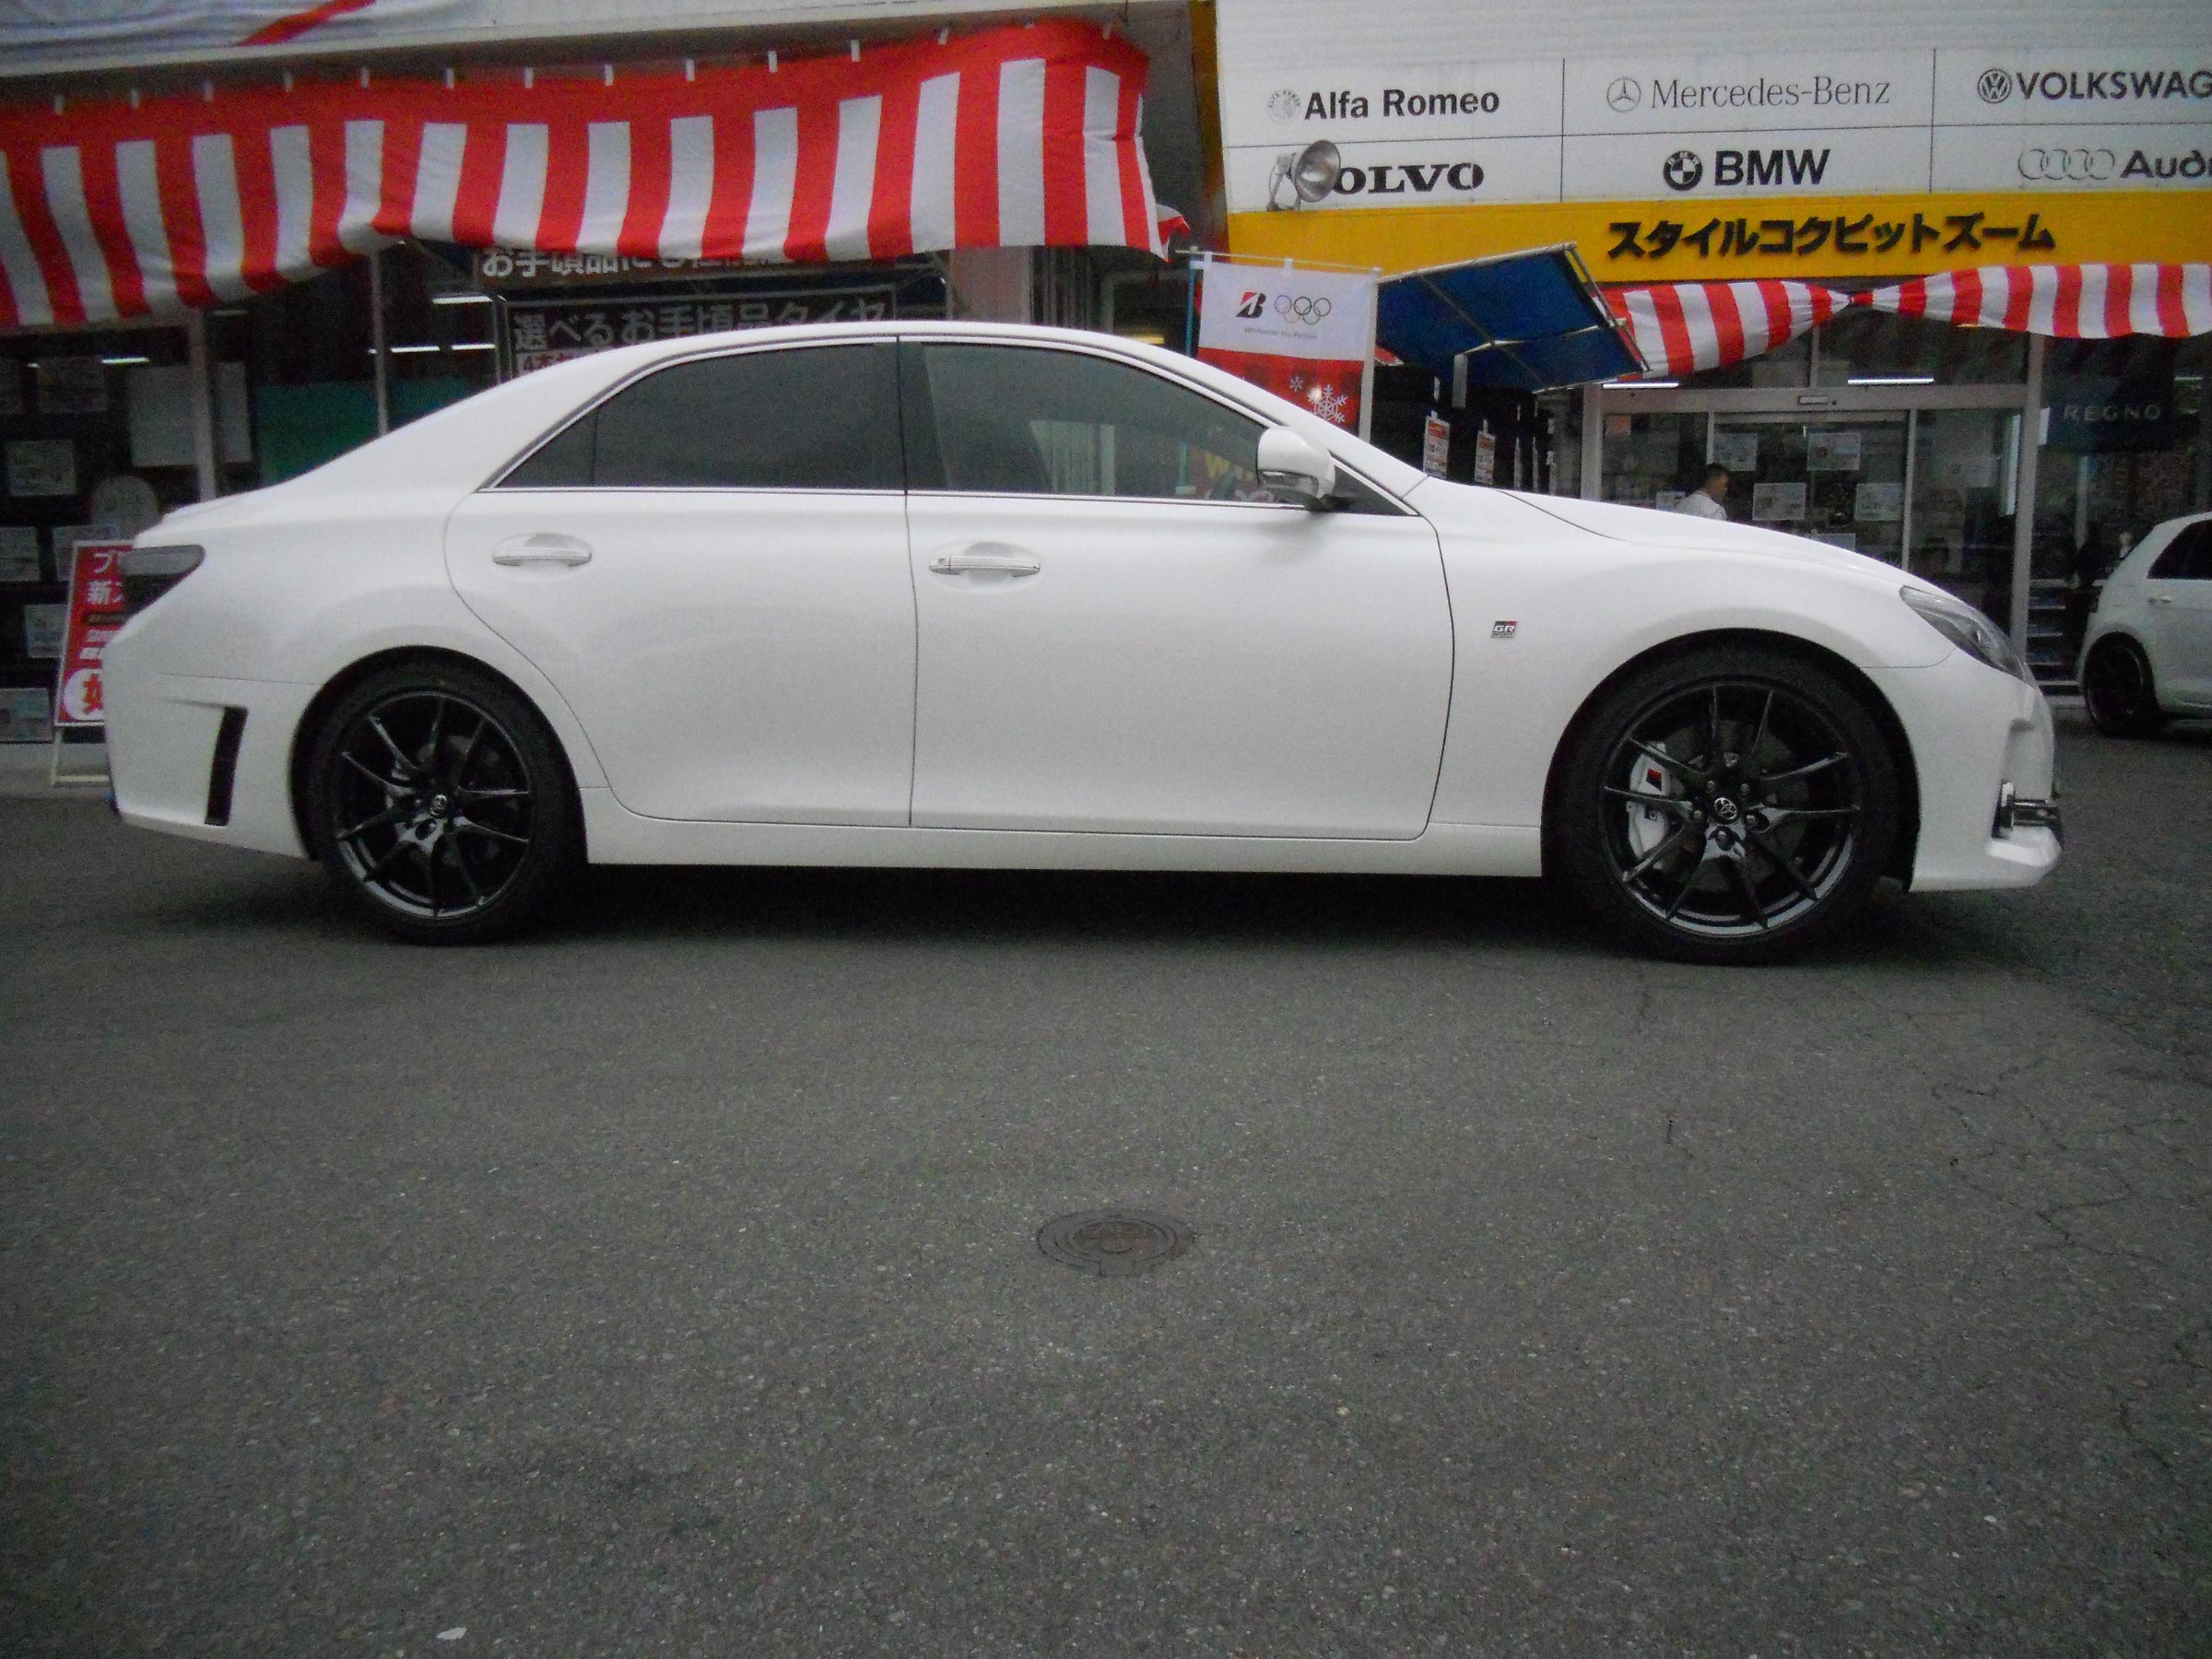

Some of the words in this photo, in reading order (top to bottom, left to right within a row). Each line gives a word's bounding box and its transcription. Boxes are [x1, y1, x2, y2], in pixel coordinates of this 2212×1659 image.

[1304, 89, 1369, 120] Alfa
[1382, 88, 1500, 117] Romeo
[1651, 76, 1890, 109] Mercedes-Benz
[1331, 162, 1485, 195] OLVO
[1715, 148, 1830, 186] BMW
[1607, 212, 2056, 260] スタイルコクピットズーム
[1493, 625, 1515, 633] GR
